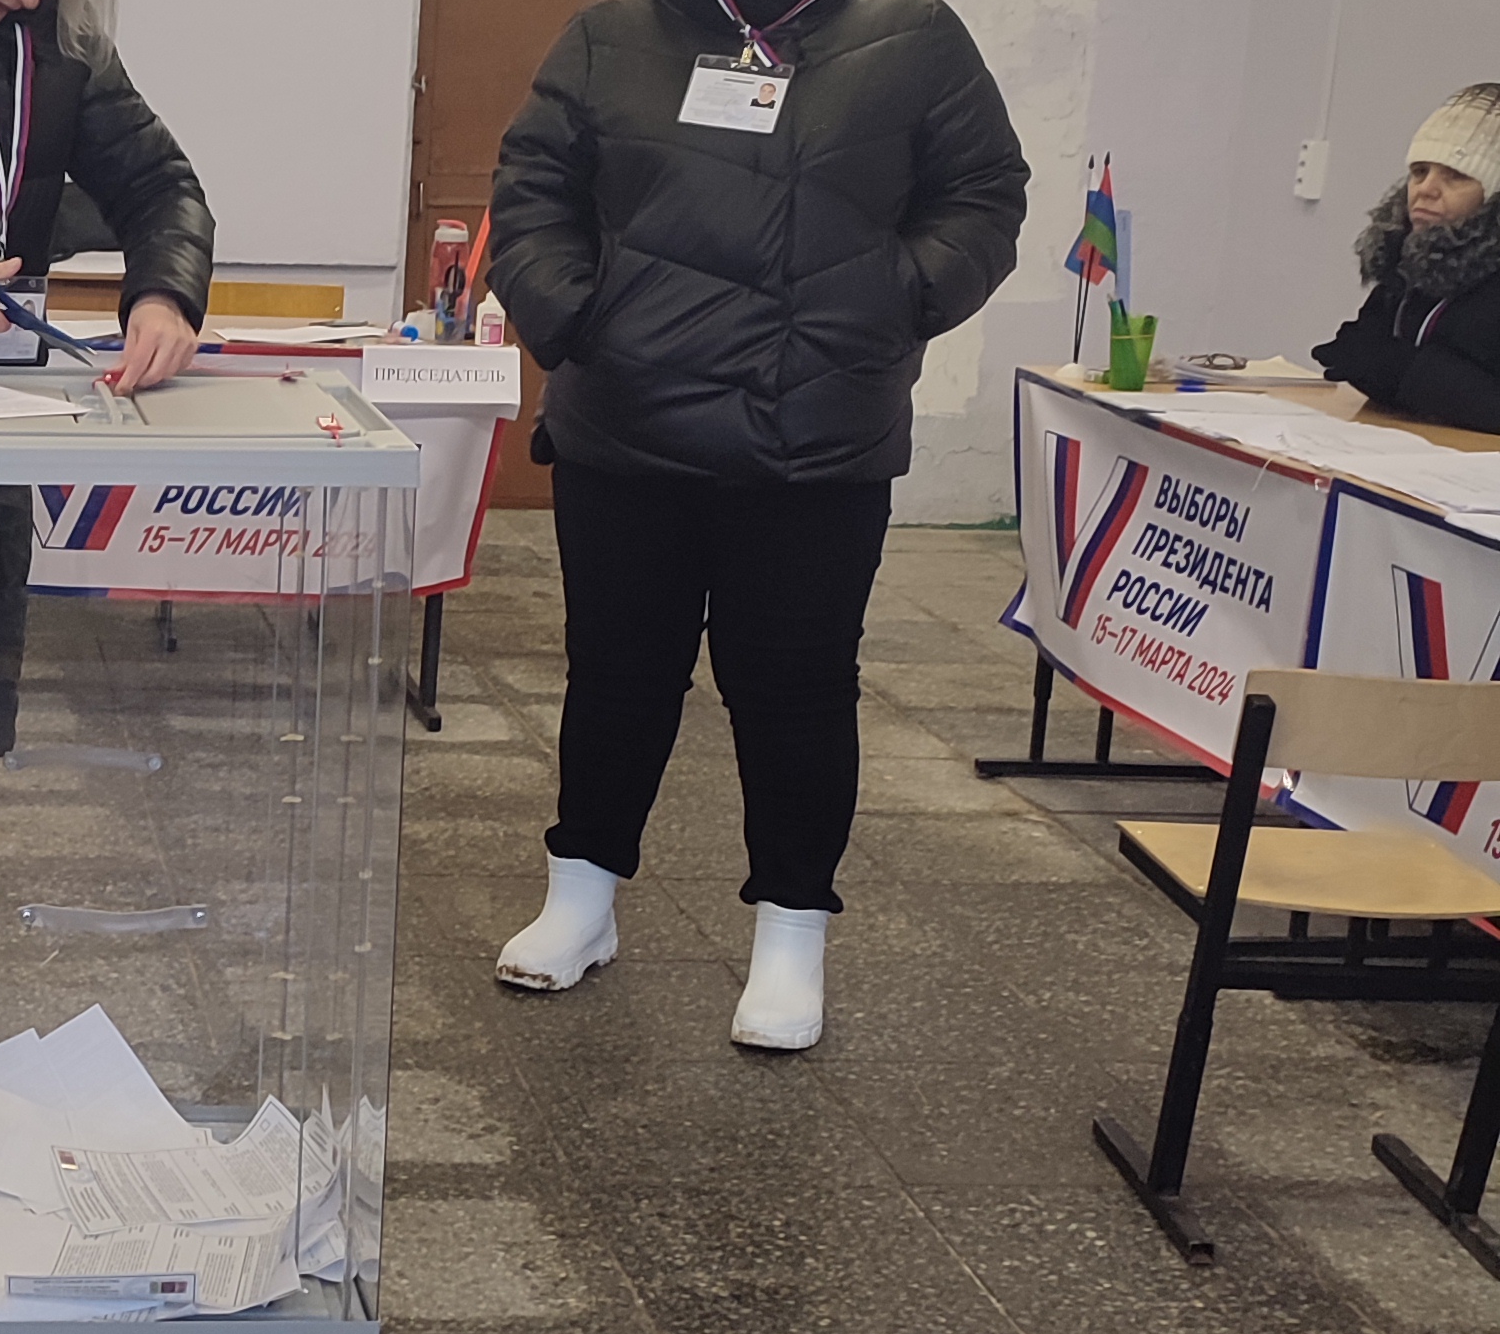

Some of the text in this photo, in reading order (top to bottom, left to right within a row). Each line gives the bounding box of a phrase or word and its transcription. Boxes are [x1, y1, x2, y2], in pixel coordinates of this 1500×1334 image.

[374, 367, 506, 383] ПРЕДСЕДАТЕЛЬ
[153, 485, 315, 518] РОССИИ
[1154, 474, 1251, 543] ВЫБОРЫ
[214, 527, 311, 557] МАРТА
[1131, 522, 1274, 614] ПРЕЗИДЕНТА
[1106, 569, 1210, 637] РОССИИ
[1131, 633, 1193, 686] МАРТА
[1187, 661, 1237, 706] 2024
